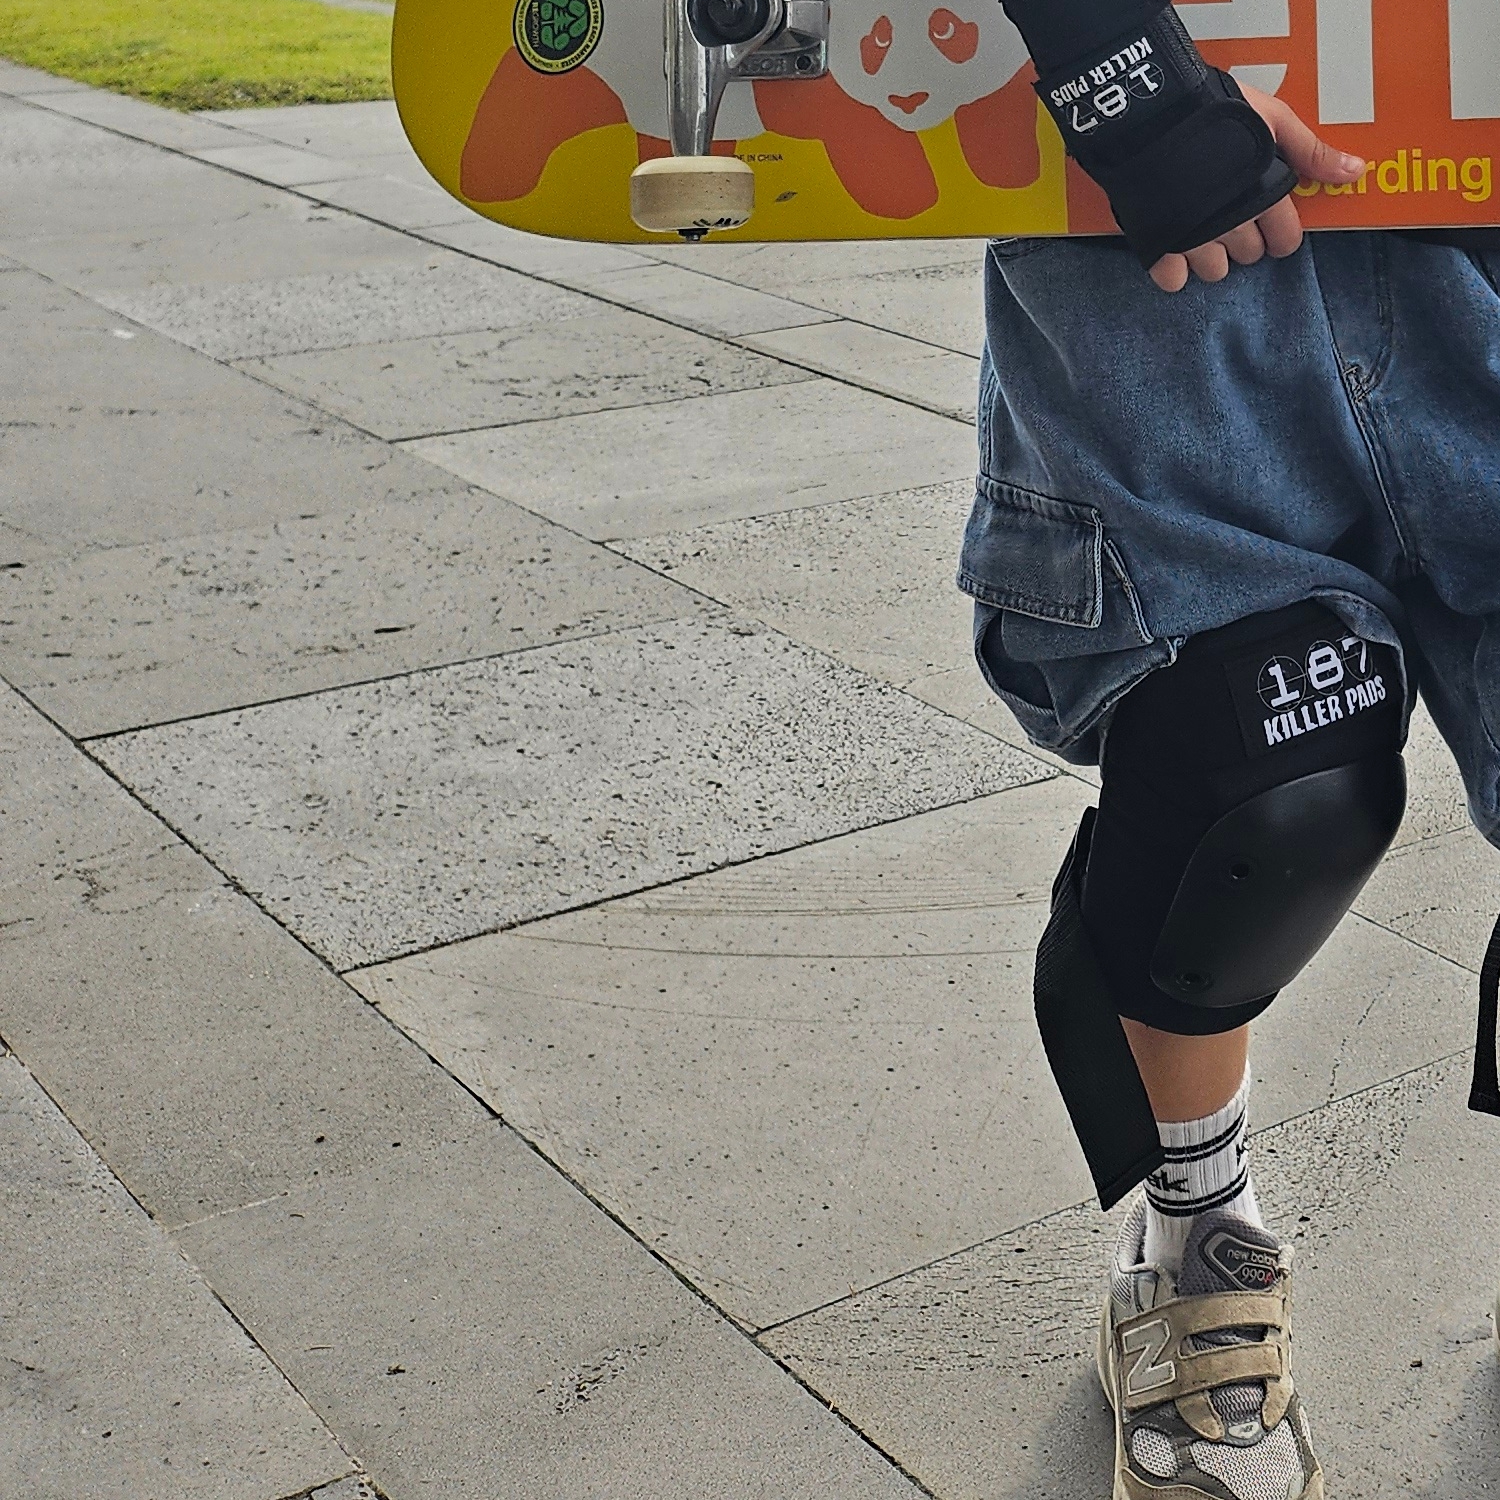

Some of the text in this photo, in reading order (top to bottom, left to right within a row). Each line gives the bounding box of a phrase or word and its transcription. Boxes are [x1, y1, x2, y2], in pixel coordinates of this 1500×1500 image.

[532, 2, 540, 48] REGROWTH
[587, 25, 599, 45] EACH
[1051, 37, 1153, 107] KILLER PADS
[1073, 63, 1158, 132] 187
[748, 154, 756, 162] IN
[758, 154, 784, 162] CHINA
[1268, 636, 1367, 708] 187
[1263, 675, 1386, 746] KILLER PADS
